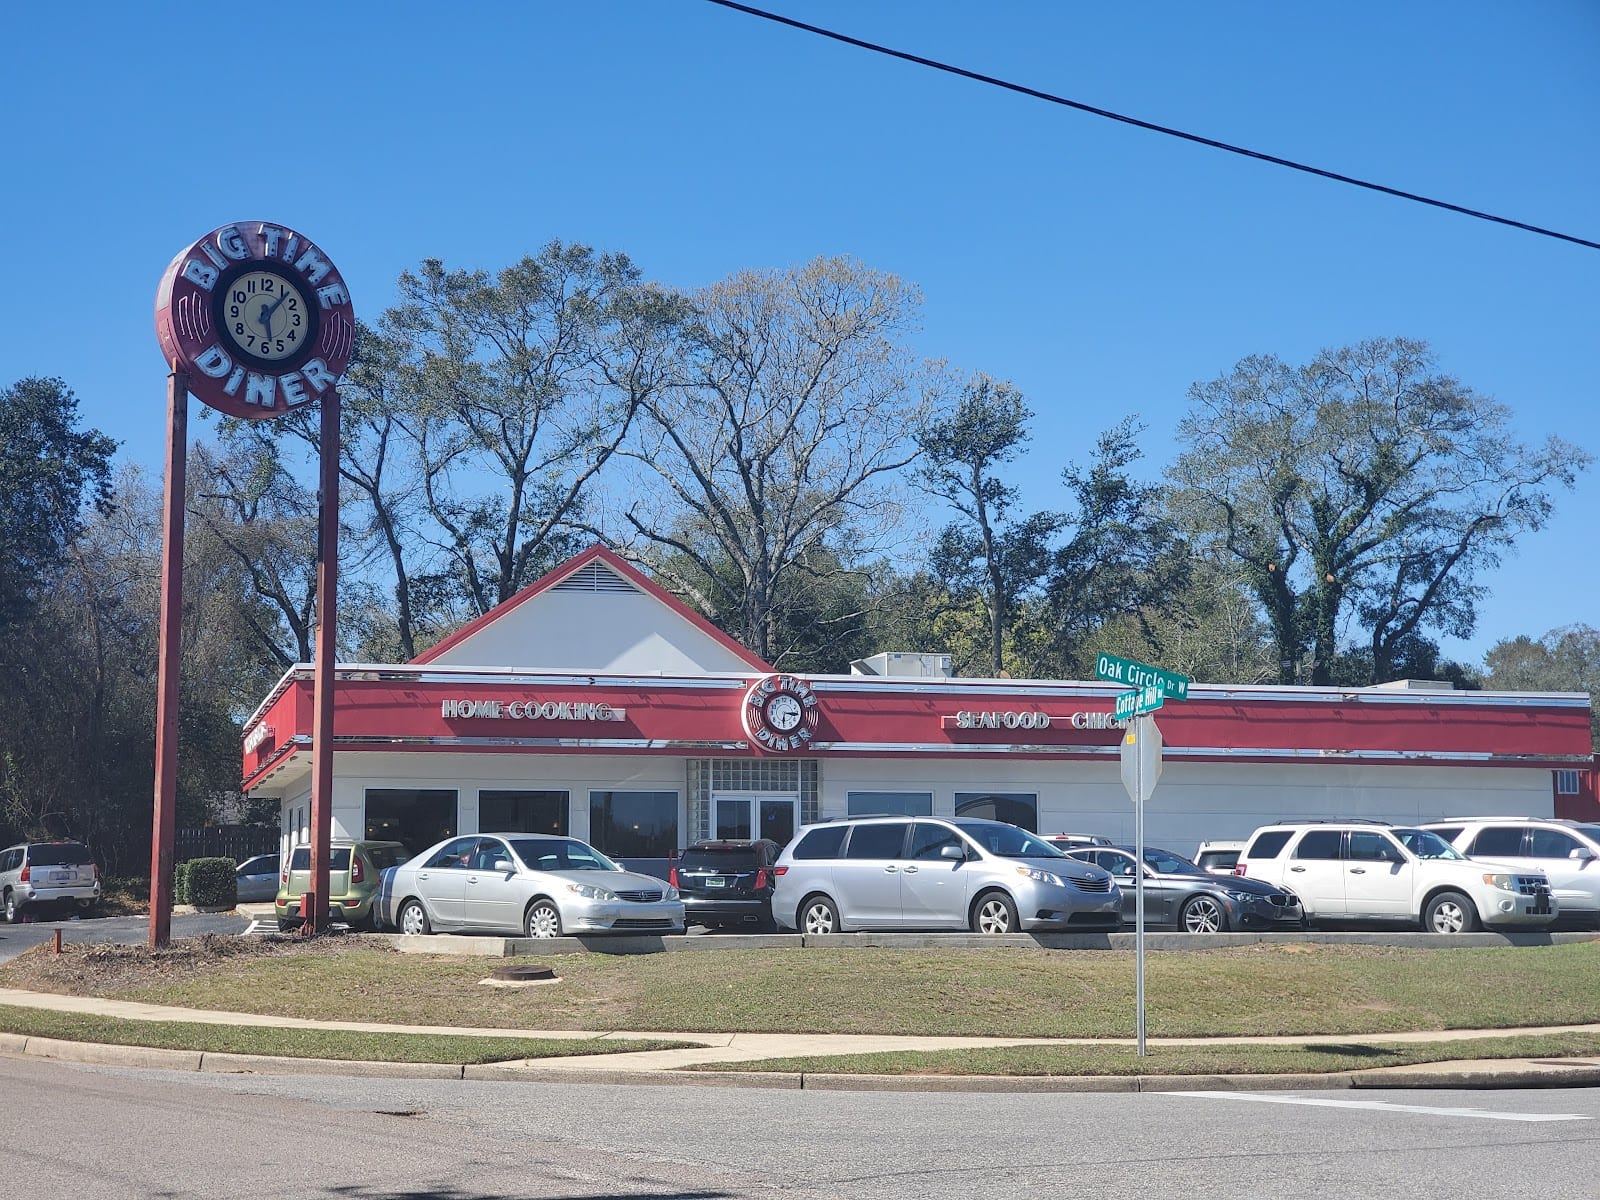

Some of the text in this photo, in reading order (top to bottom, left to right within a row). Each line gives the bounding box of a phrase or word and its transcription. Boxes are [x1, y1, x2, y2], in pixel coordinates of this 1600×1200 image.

[181, 224, 351, 310] BIG TIME
[247, 280, 256, 293] 11
[261, 278, 274, 292] 12
[233, 290, 247, 304] 10
[230, 305, 239, 318] 9
[288, 298, 297, 311] 2
[292, 313, 301, 327] 3
[235, 322, 244, 335] 8
[287, 329, 296, 341] 4
[246, 335, 255, 347] 7
[261, 342, 269, 354] 6
[276, 339, 285, 352] 5
[193, 342, 338, 408] DINER
[1099, 657, 1123, 680] Oak
[1167, 680, 1175, 691] Dr
[1178, 681, 1186, 695] W
[1116, 693, 1144, 715] Cottage
[1145, 686, 1158, 707] Hill
[442, 700, 613, 721] HOME COOKING
[956, 711, 1050, 729] SEAFOOD
[755, 727, 812, 750] DINER
